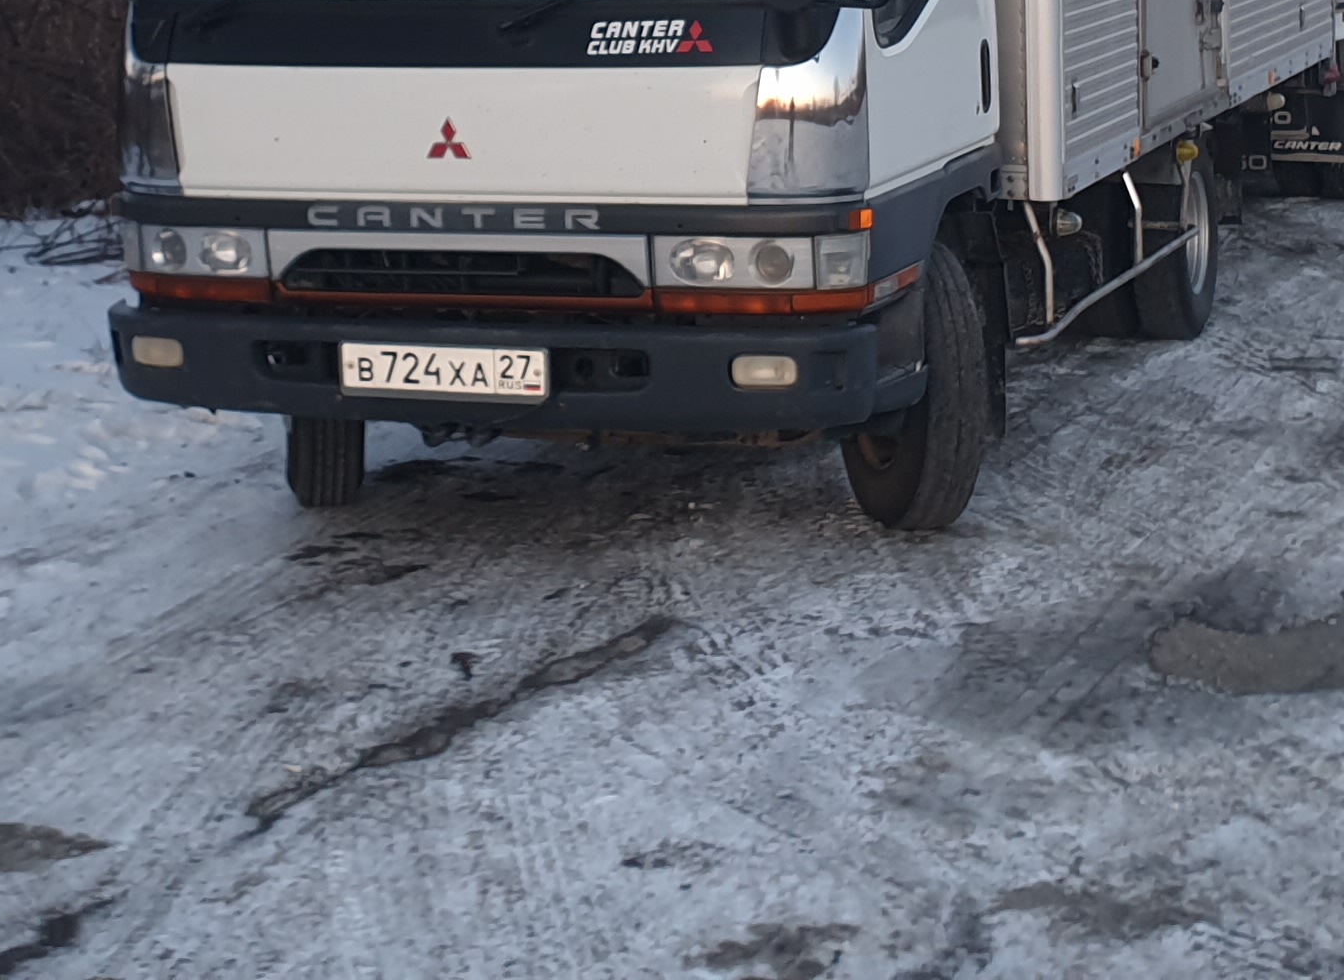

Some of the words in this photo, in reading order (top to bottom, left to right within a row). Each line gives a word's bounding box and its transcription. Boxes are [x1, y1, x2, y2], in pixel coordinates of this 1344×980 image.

[590, 19, 685, 39] CANTER
[586, 40, 636, 55] CLUB
[637, 39, 679, 54] KHV
[1273, 140, 1342, 151] CANTER
[307, 205, 601, 230] CANTER
[499, 354, 531, 380] 27
[498, 380, 523, 390] RUS
